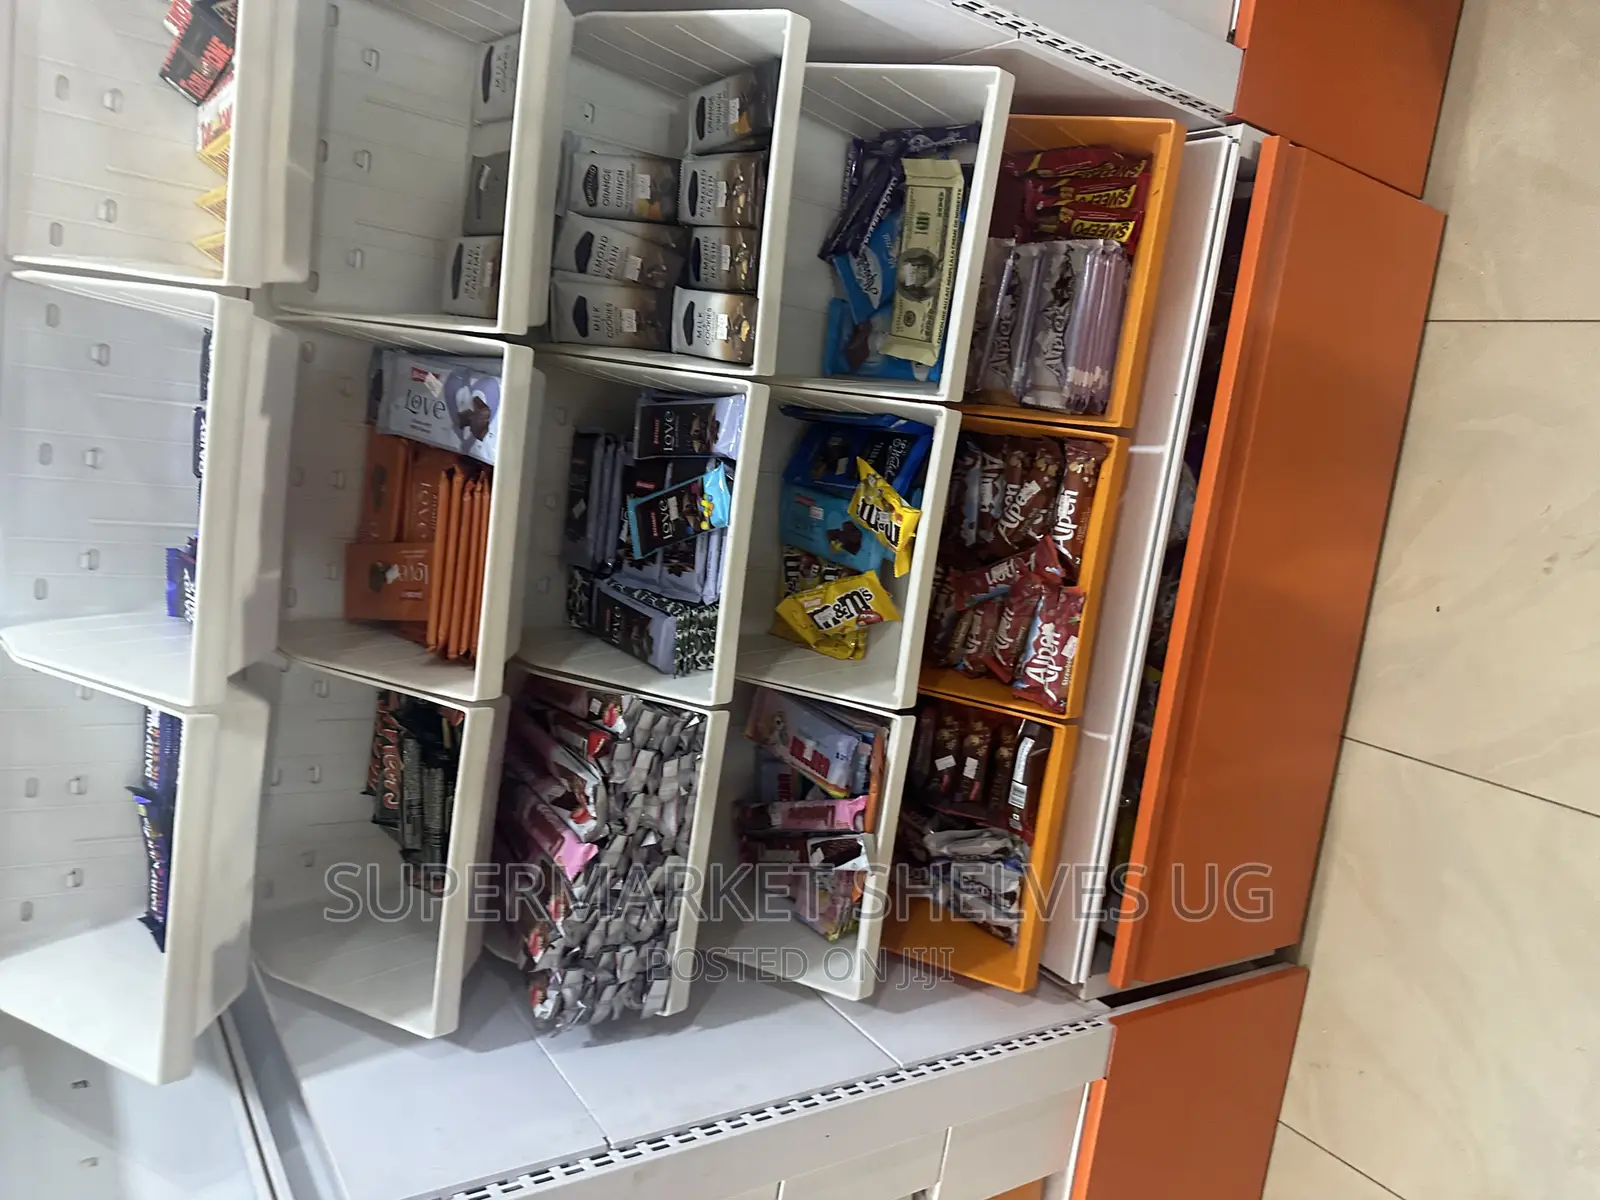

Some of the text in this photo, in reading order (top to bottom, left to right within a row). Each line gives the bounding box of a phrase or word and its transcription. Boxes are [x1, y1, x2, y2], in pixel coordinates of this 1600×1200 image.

[1073, 221, 1130, 243] SWEEPO
[592, 306, 601, 332] MILK
[604, 302, 613, 339] COOKIES
[1051, 488, 1079, 560] Alpen
[1025, 630, 1062, 702] Alpen
